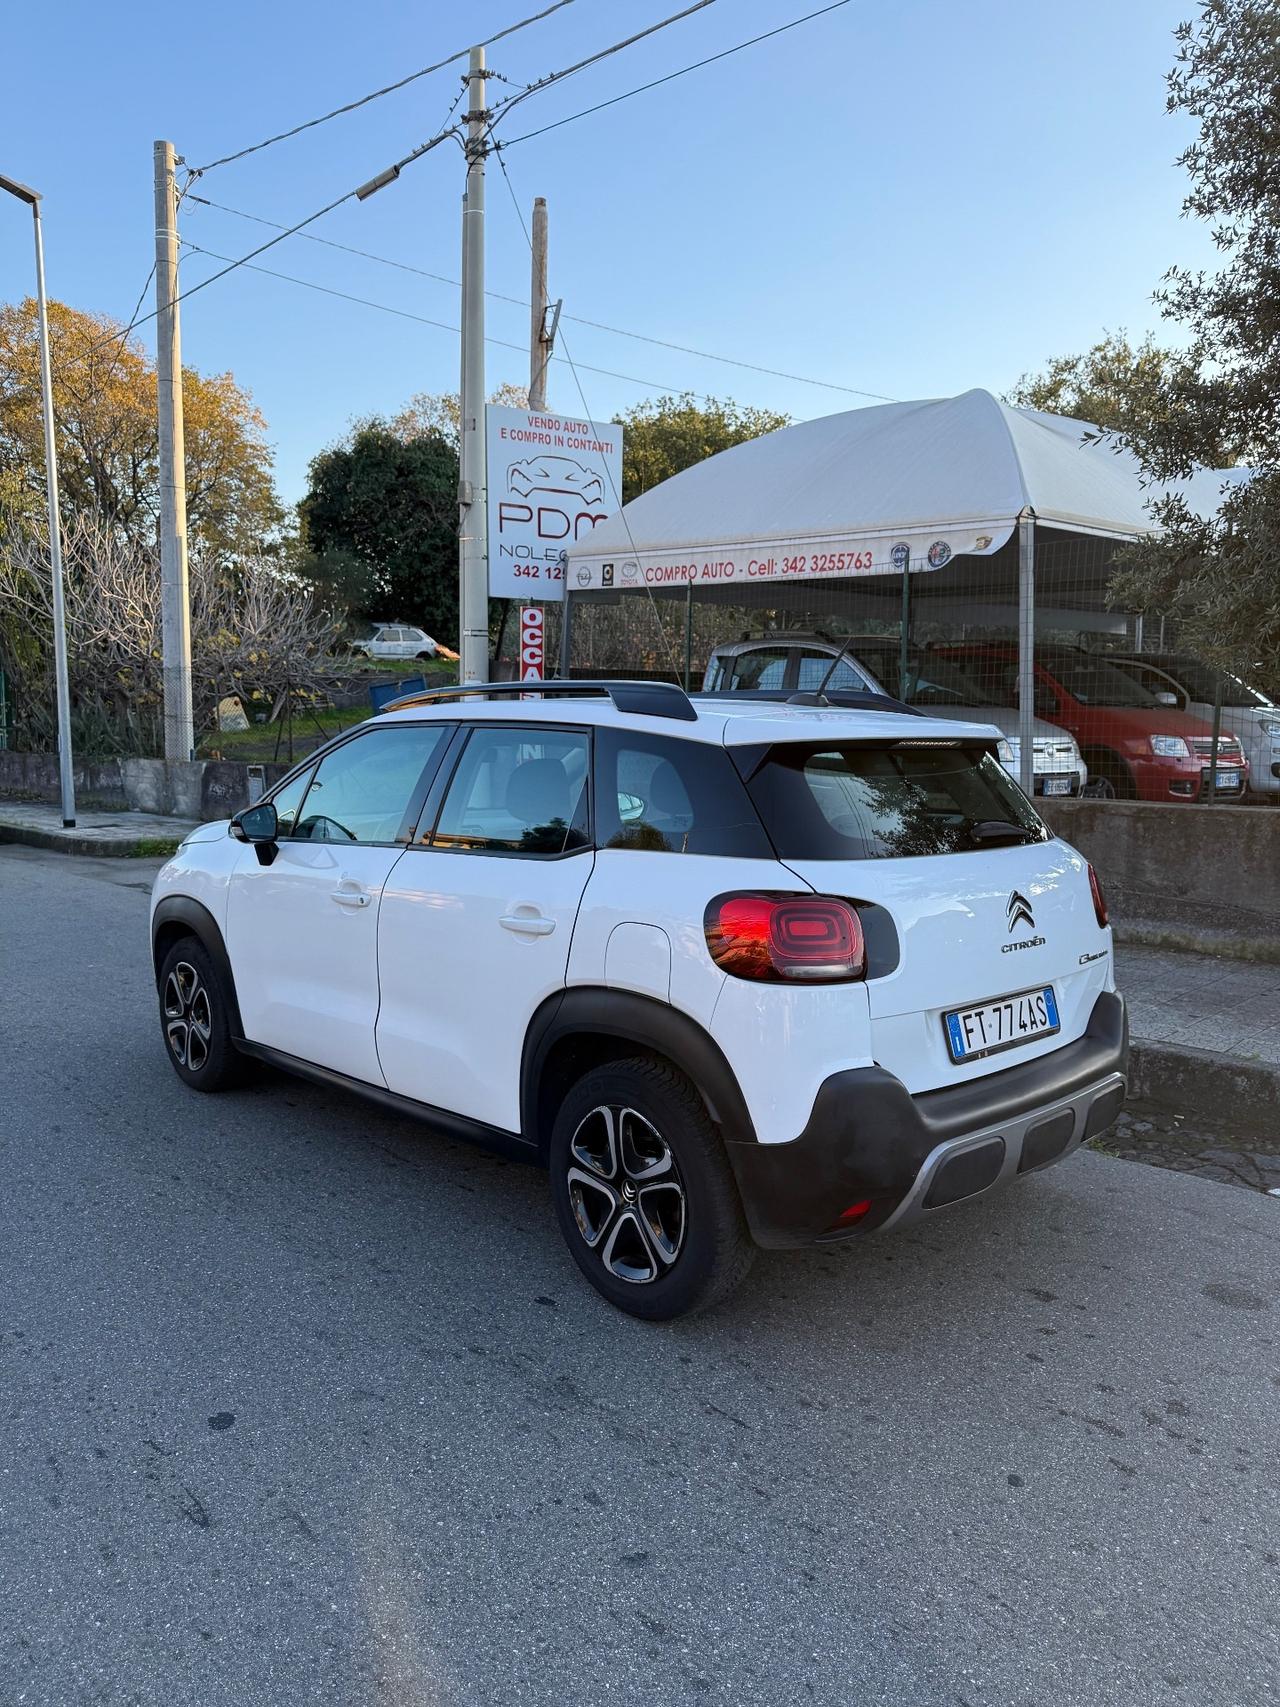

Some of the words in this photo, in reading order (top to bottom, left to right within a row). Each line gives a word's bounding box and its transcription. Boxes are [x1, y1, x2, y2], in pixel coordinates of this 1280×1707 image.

[528, 416, 561, 431] VENDO
[563, 422, 589, 435] AUTO
[501, 428, 507, 439] E
[510, 429, 551, 445] COMPRO
[555, 435, 564, 447] IN
[567, 438, 613, 453] CONTANTI
[513, 564, 540, 578] 342
[646, 564, 698, 582] COMPRO
[701, 561, 735, 578] AUTO
[748, 558, 778, 577] Cell:
[782, 556, 806, 574] 342
[810, 551, 873, 572] 3255763
